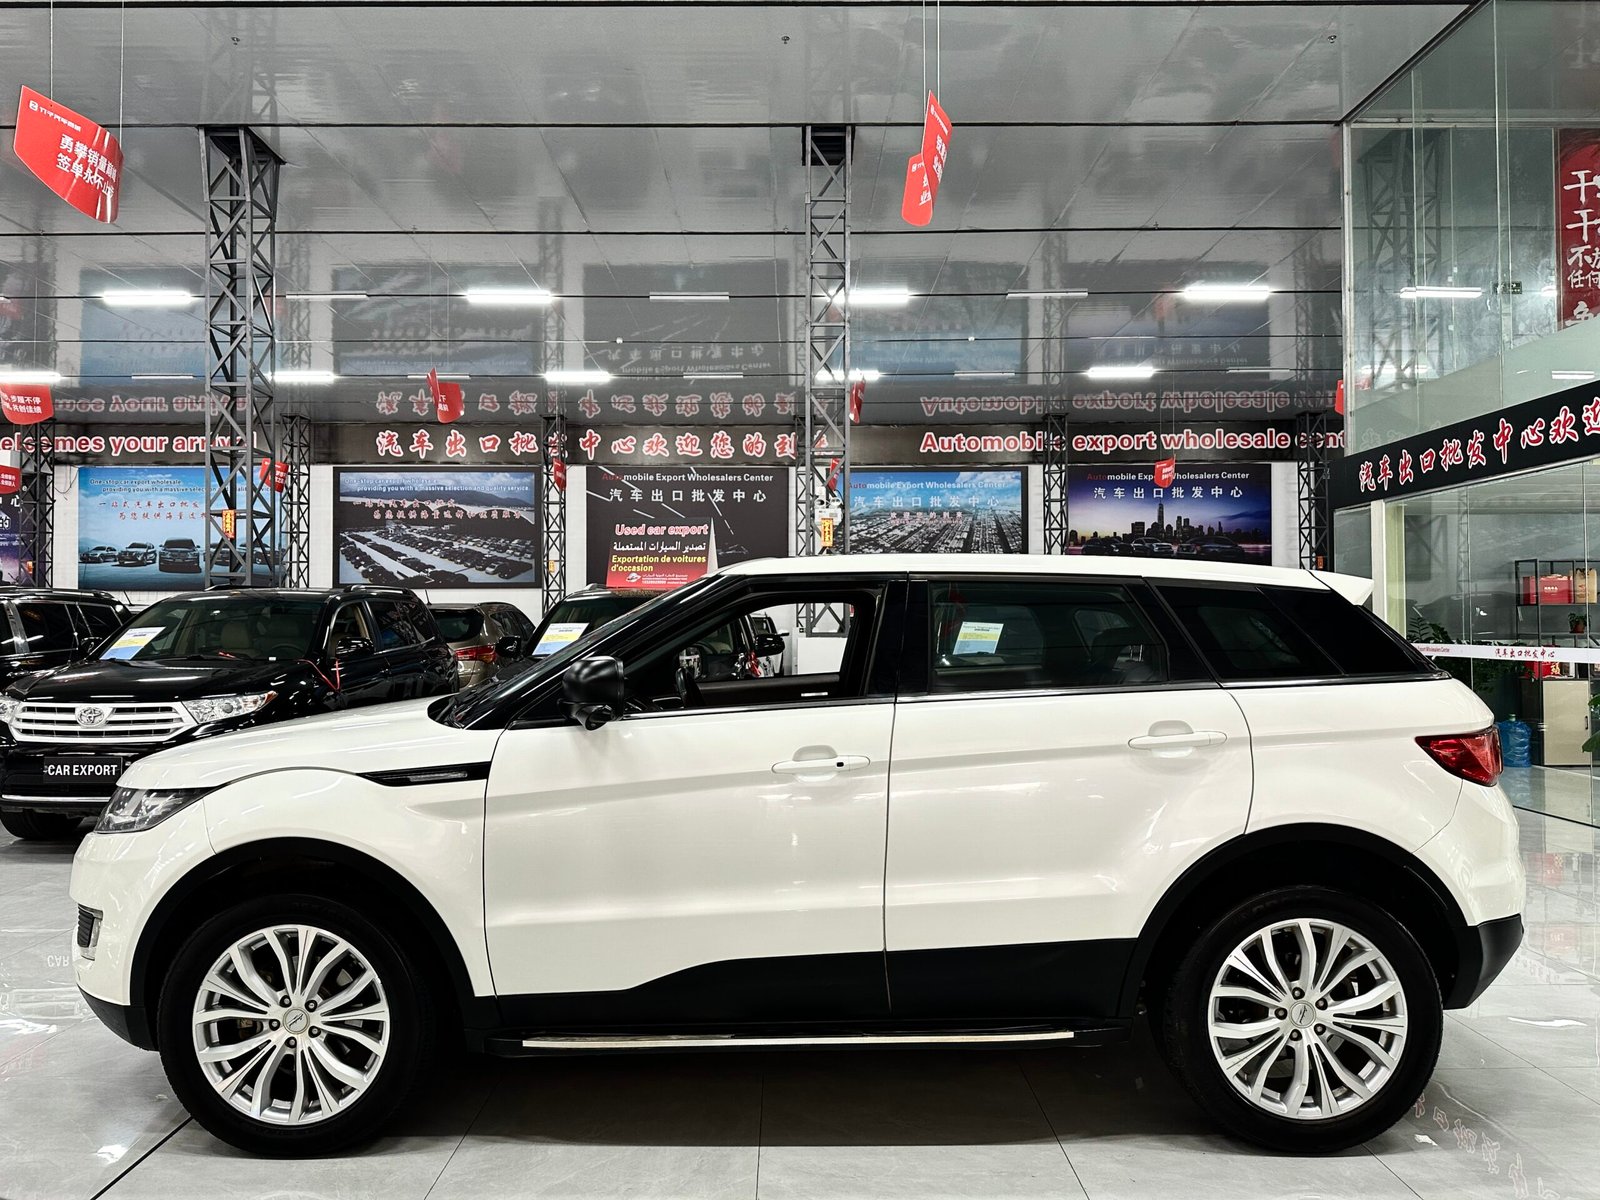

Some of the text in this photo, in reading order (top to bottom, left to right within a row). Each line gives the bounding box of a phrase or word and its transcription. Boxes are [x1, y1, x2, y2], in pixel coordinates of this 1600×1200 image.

[109, 436, 169, 456] your
[172, 431, 258, 453] arriv
[1072, 430, 1156, 455] export
[1160, 428, 1291, 449] wholesale
[656, 473, 686, 483] Export
[687, 473, 742, 482] Wholesalers
[743, 473, 773, 482] Center
[1138, 472, 1155, 483] Exp
[1221, 471, 1250, 480] Center
[357, 485, 387, 493] providing
[485, 485, 507, 493] quality
[897, 481, 924, 490] Export
[925, 481, 977, 489] Wholesalers
[609, 488, 767, 503] 汽车出口批发中心
[1093, 486, 1243, 500] 汽车出口批发中心
[853, 495, 1000, 508] 汽车出口批发中心
[615, 523, 709, 537] Used car export
[611, 555, 706, 564] Exportation de voitures
[610, 564, 653, 572] d'occasion
[48, 764, 118, 776] CAR EXPORT
